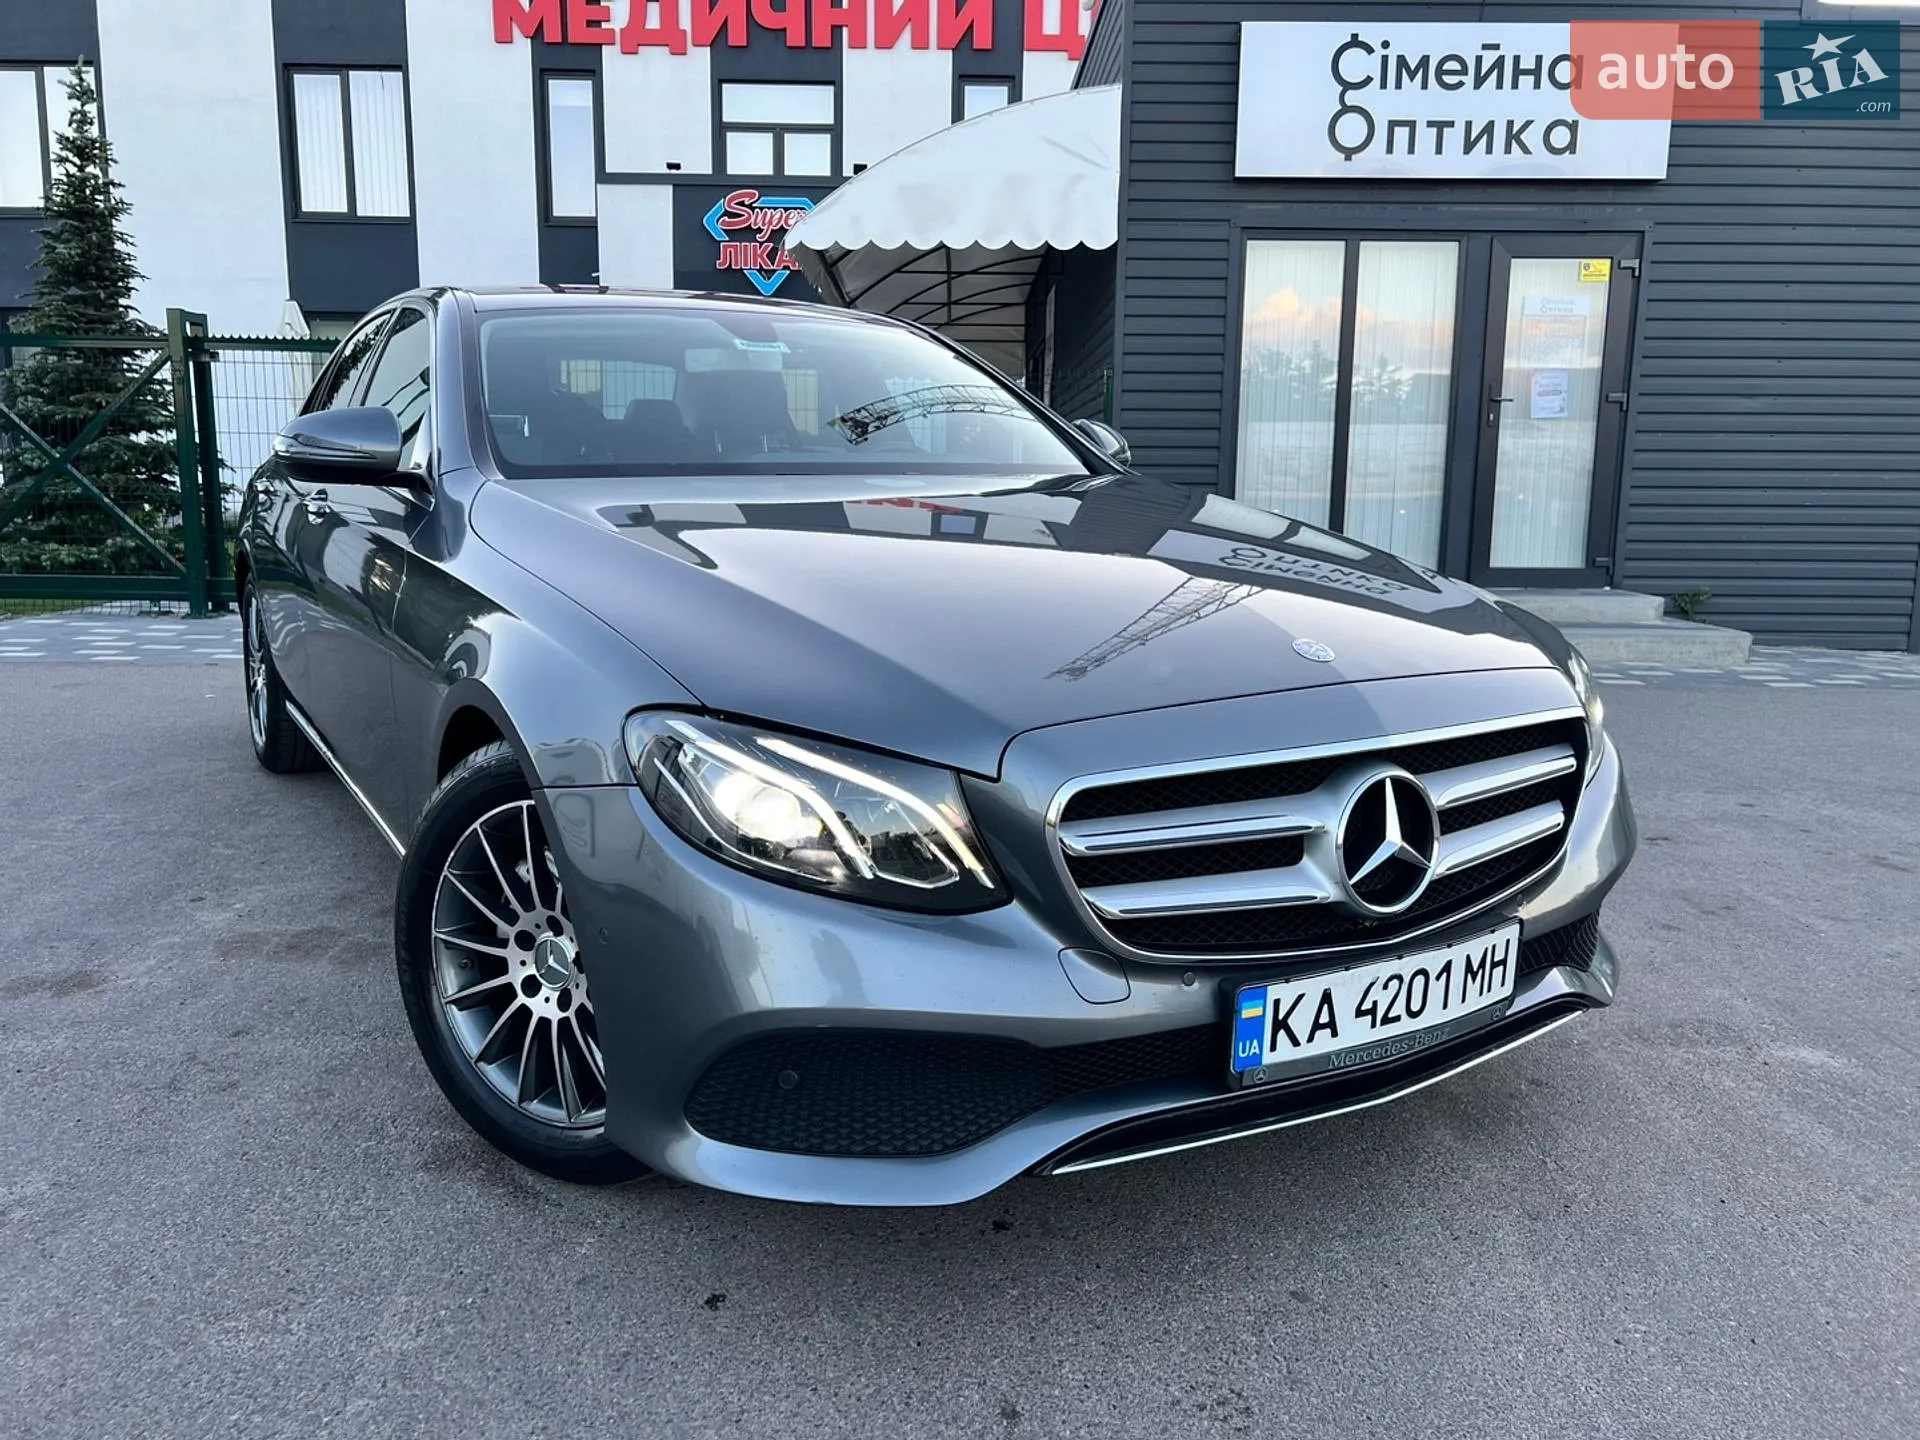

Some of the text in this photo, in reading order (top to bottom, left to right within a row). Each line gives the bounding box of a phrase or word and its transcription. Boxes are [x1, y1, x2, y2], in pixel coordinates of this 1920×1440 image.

[1023, 0, 1101, 60] Ц
[1331, 33, 1584, 91] Сімейна
[1327, 105, 1580, 161] Оптика
[1268, 937, 1511, 1053] KA 4201 MH
[1238, 1038, 1261, 1058] UA
[1328, 1026, 1451, 1070] Mercedes-Benz
